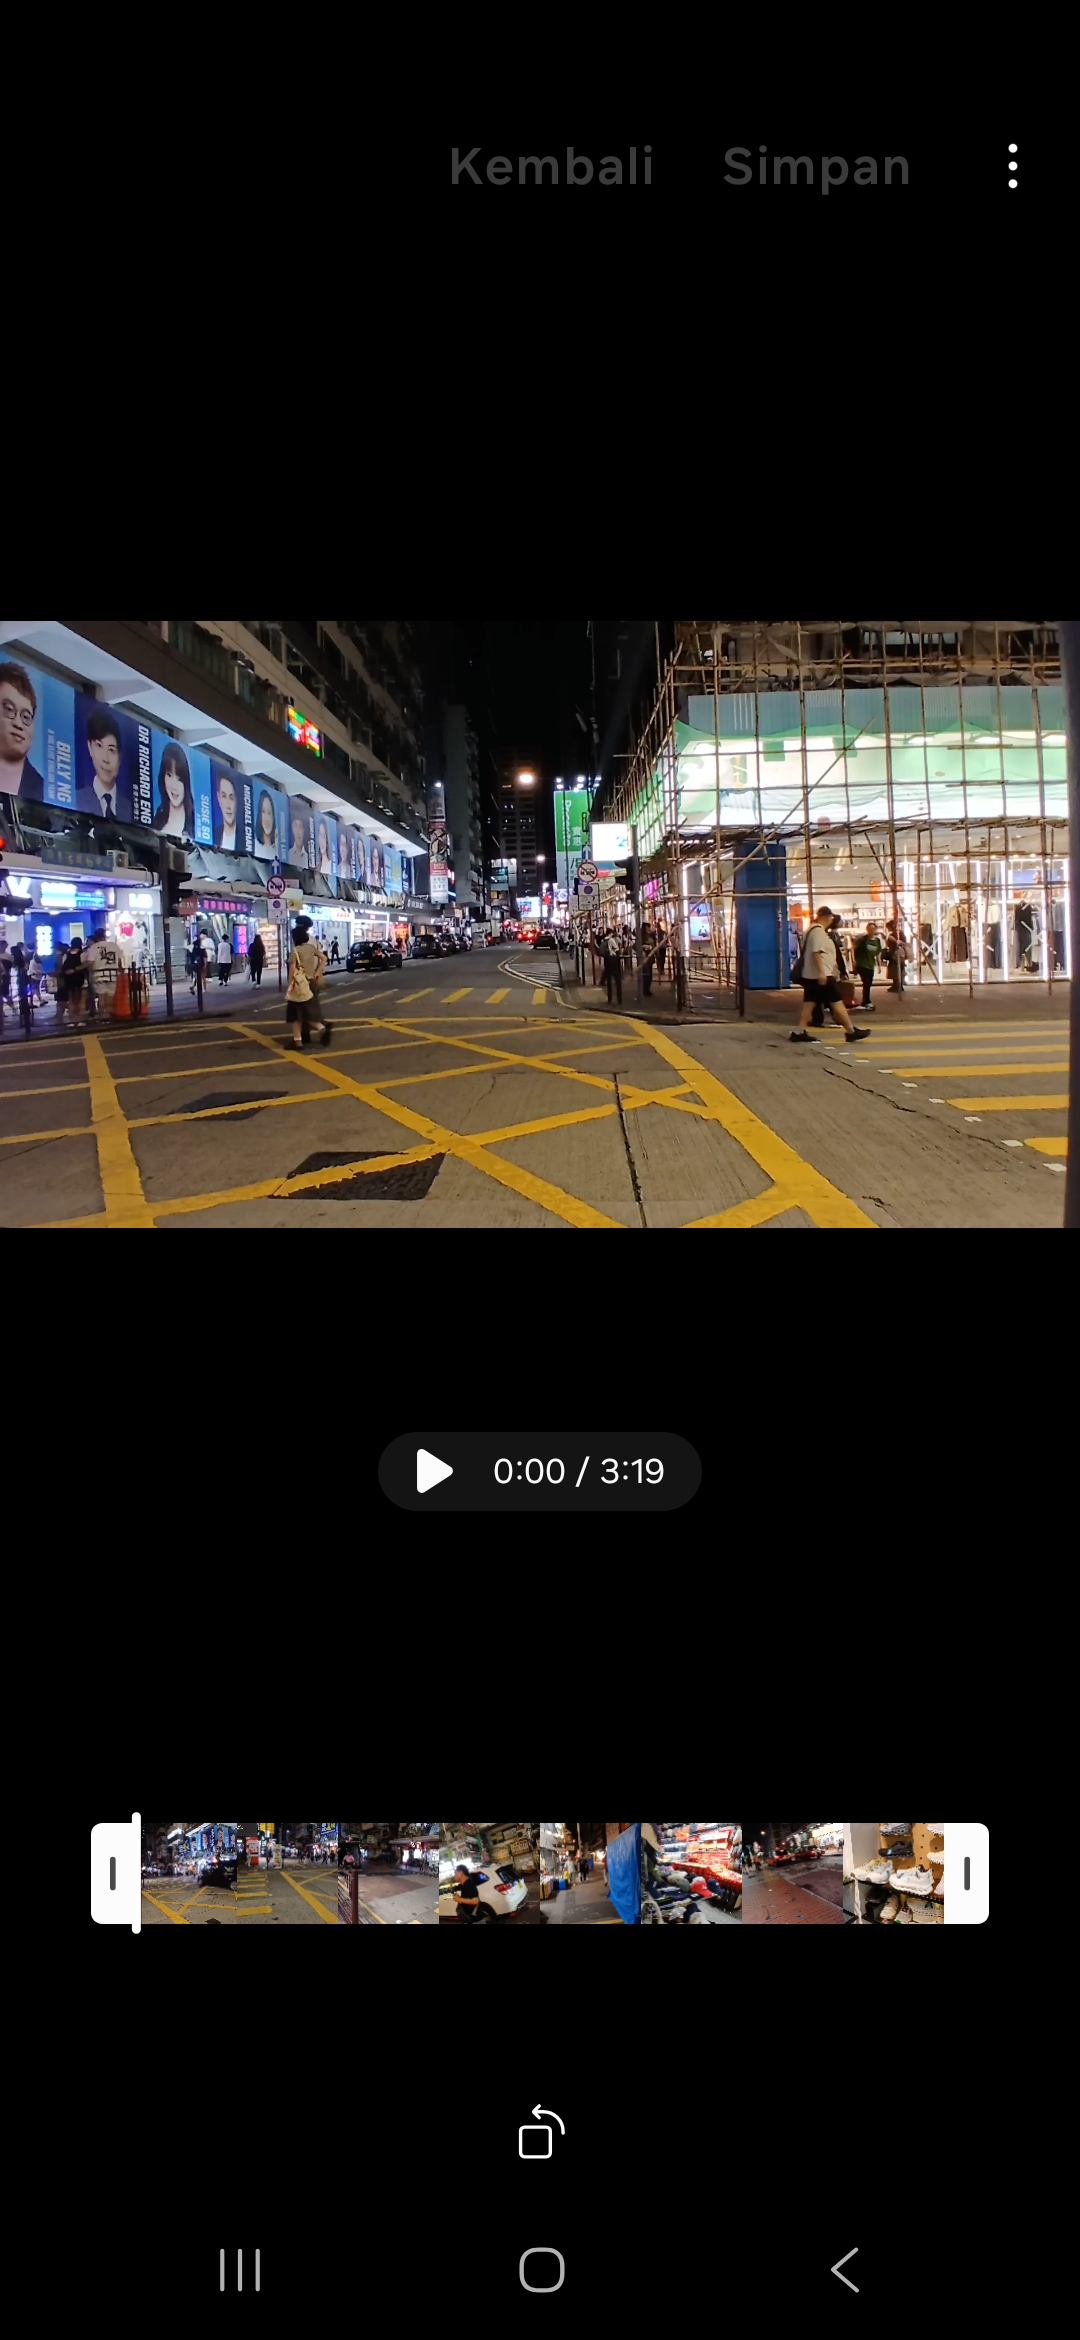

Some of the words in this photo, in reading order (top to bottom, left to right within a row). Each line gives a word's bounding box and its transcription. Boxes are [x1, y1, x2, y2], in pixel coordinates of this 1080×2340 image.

[138, 725, 149, 744] DR
[56, 740, 72, 780] BILLY
[138, 744, 151, 799] RICHARD
[57, 781, 72, 803] NG
[243, 784, 253, 825] MICHAEL
[140, 799, 152, 825] ENG
[200, 794, 210, 825] SUSIE
[201, 825, 211, 840] SO
[245, 826, 253, 853] CHAN
